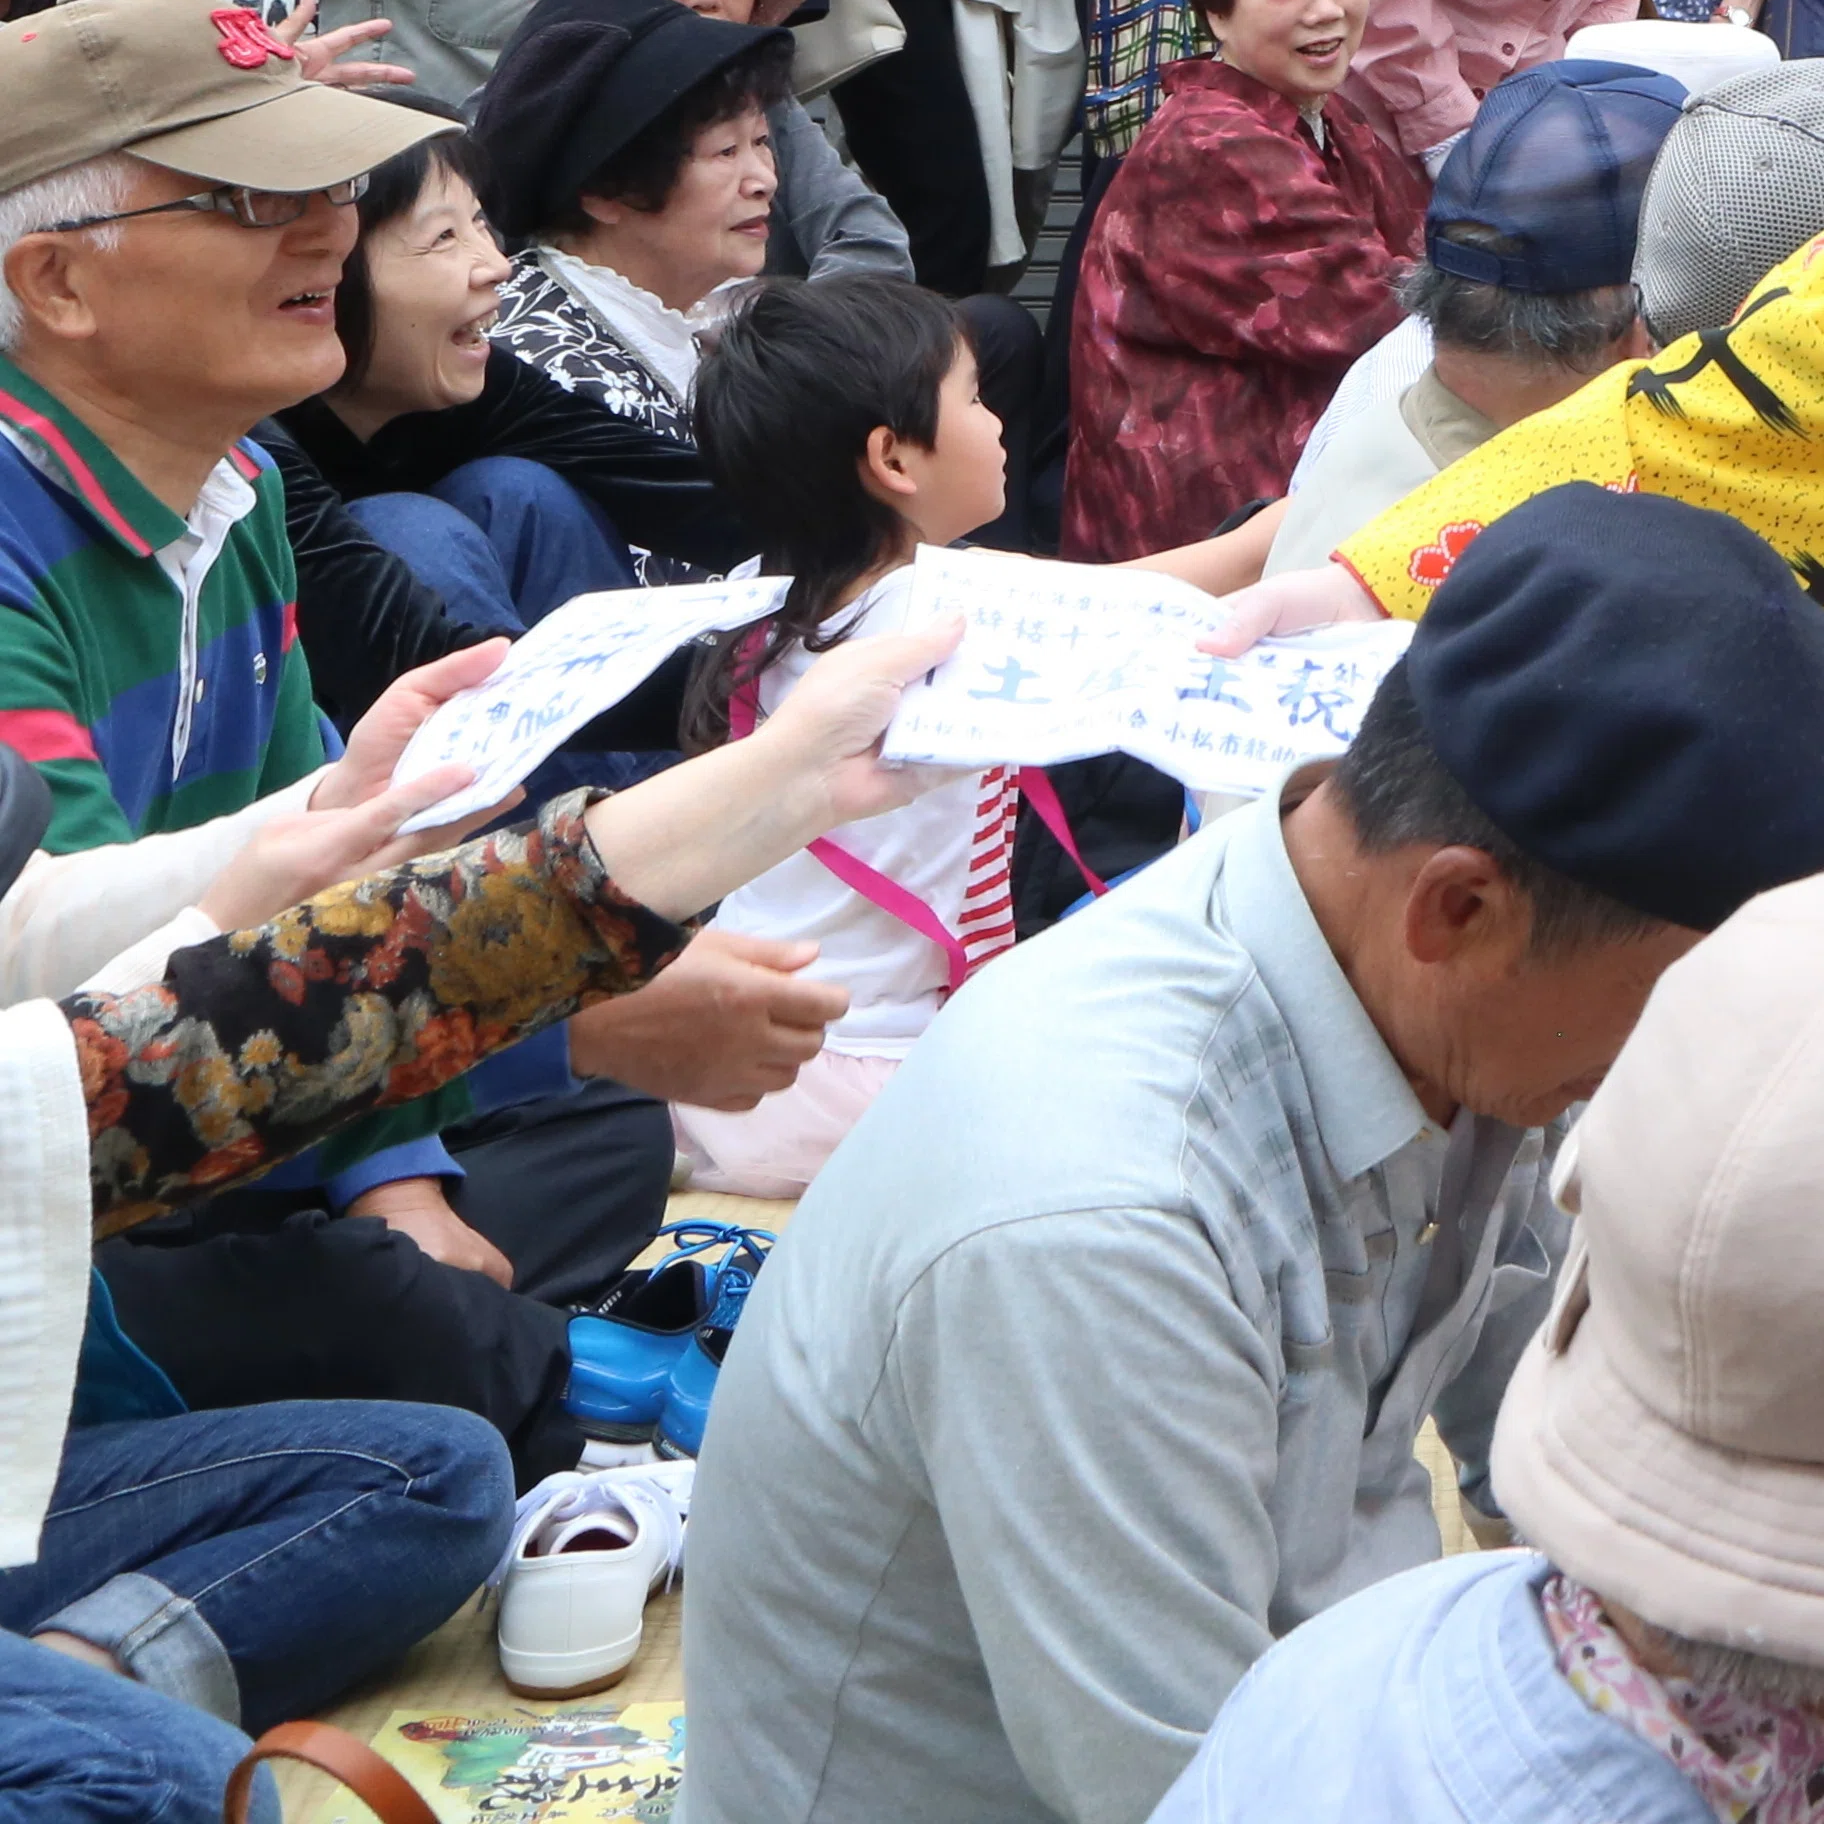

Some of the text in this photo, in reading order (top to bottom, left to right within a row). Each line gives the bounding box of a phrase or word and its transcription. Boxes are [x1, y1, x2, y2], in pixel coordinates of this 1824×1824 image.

[1162, 720, 1313, 764] 小松市龍助
